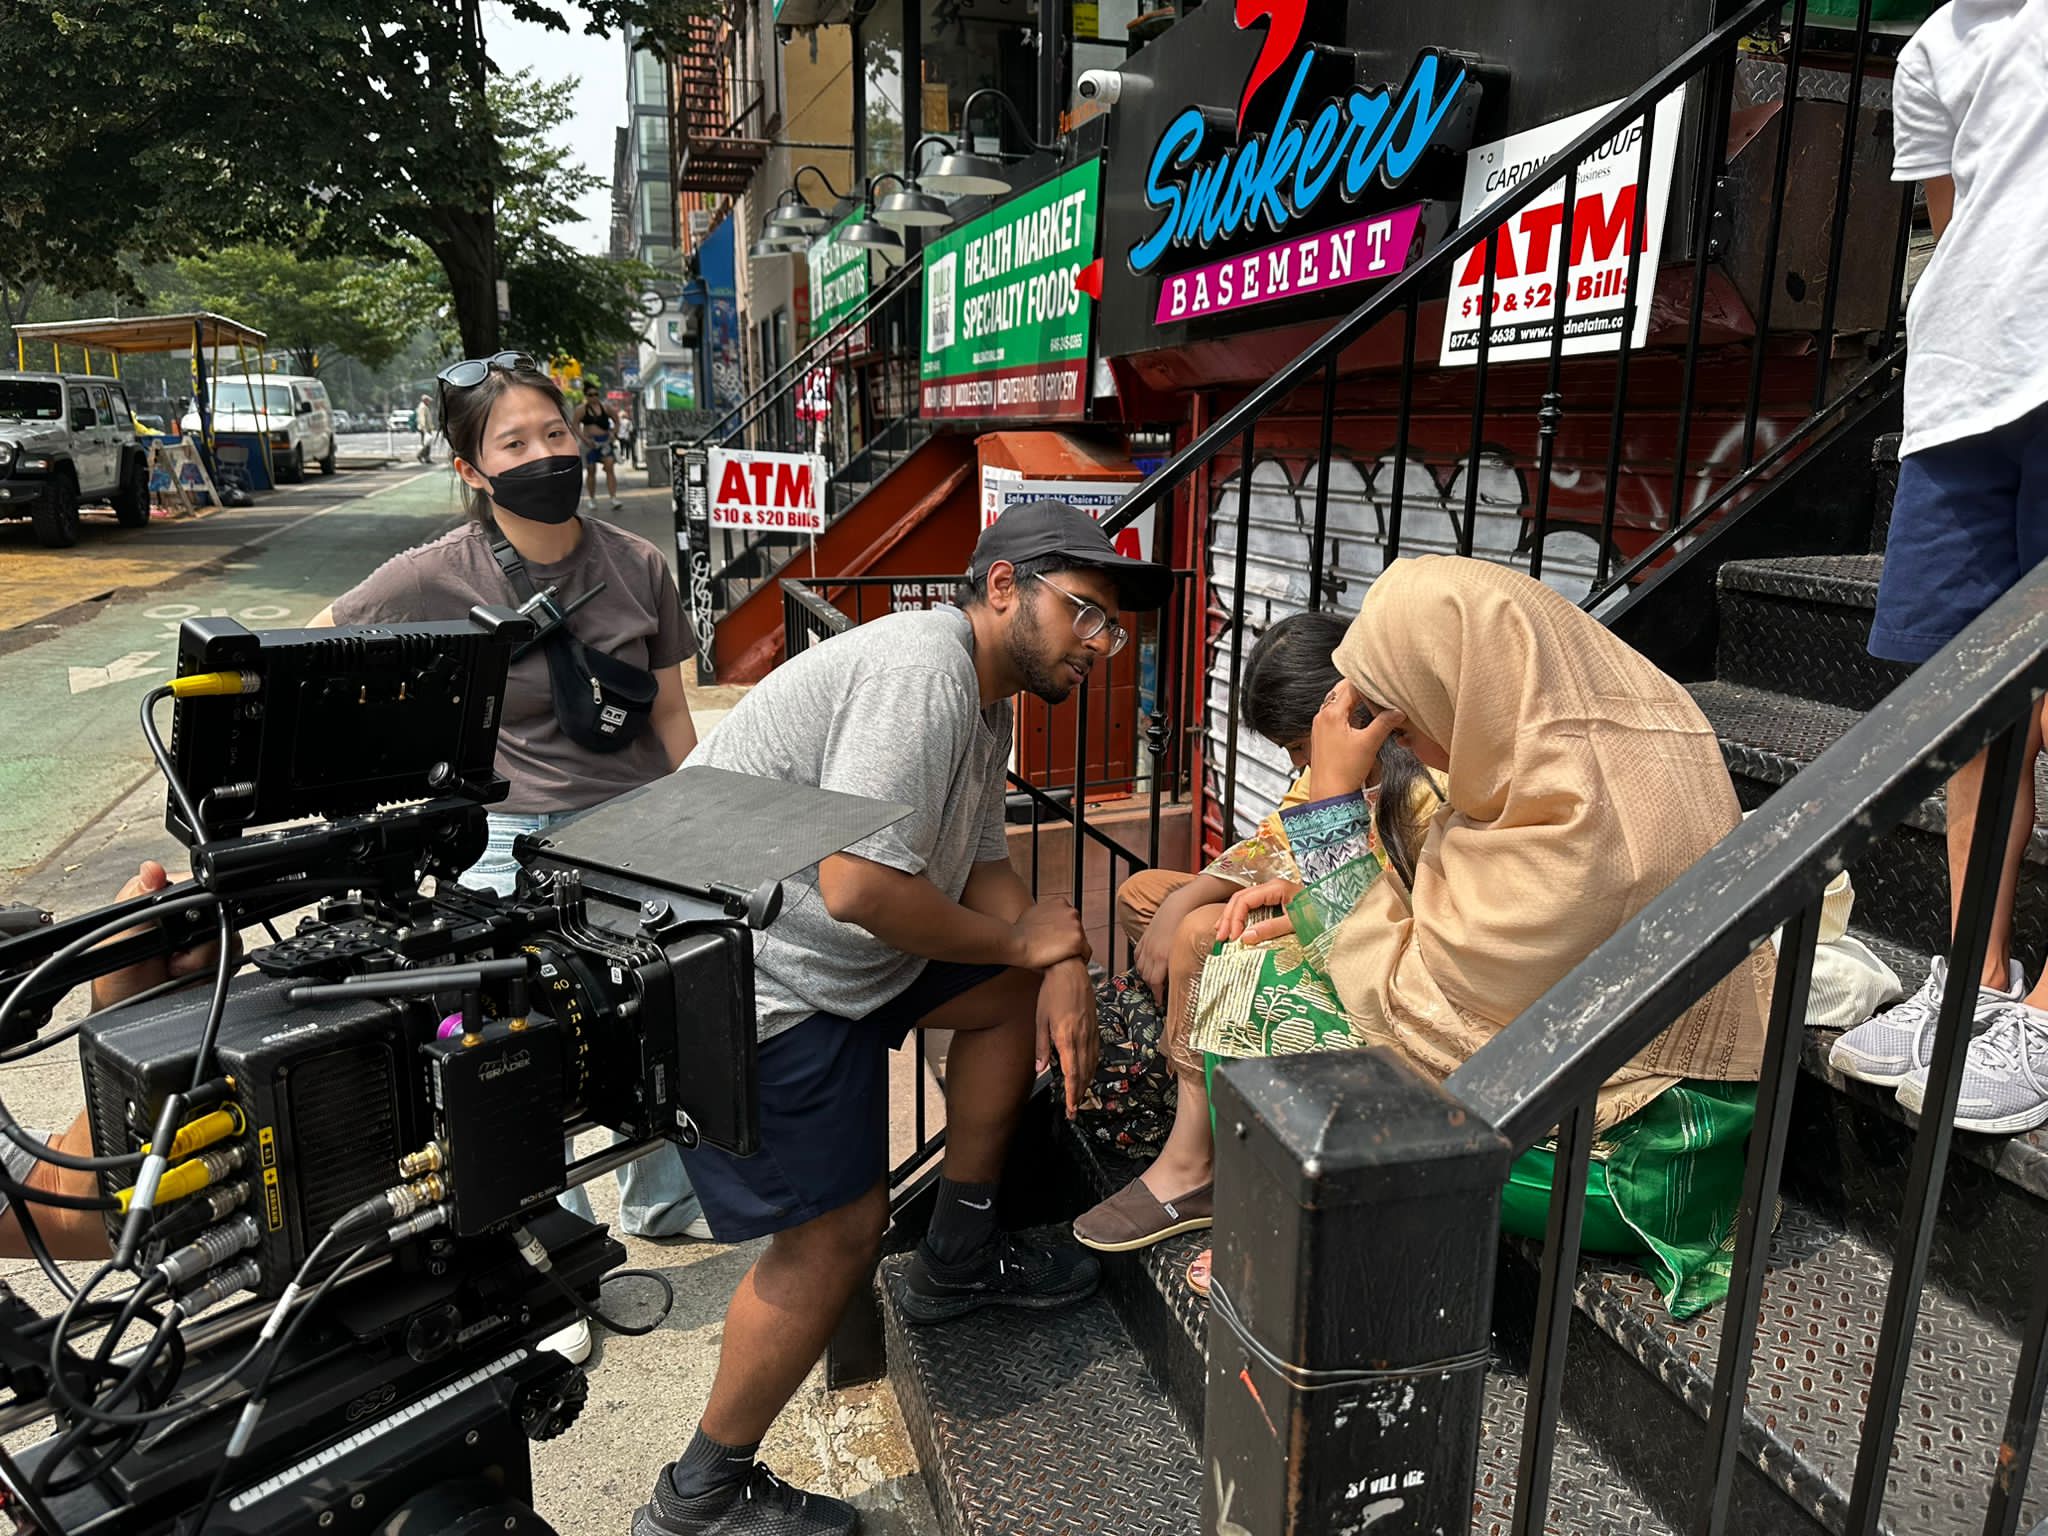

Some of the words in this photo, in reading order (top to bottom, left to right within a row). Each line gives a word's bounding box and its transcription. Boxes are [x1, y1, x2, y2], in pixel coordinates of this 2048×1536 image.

[1129, 50, 1466, 268] Smokers
[1486, 155, 1547, 192] CARD
[1583, 126, 1642, 165] OUP
[964, 224, 1012, 288] HEALTH
[1014, 189, 1086, 269] MARKET
[1170, 219, 1393, 316] BASEMENT
[1458, 183, 1648, 287] ATM
[962, 280, 1025, 340] SPECIALTY
[1027, 262, 1081, 325] FOODS
[1451, 327, 1516, 348] 877-6-6638
[1520, 316, 1624, 340] www.cdnetatm.co
[1503, 293, 1518, 312] &
[714, 508, 739, 523] $10
[743, 512, 752, 524] &
[757, 510, 784, 526] $20
[717, 460, 816, 508] ATM
[1007, 493, 1024, 504] Safe
[1068, 495, 1093, 505] Choice
